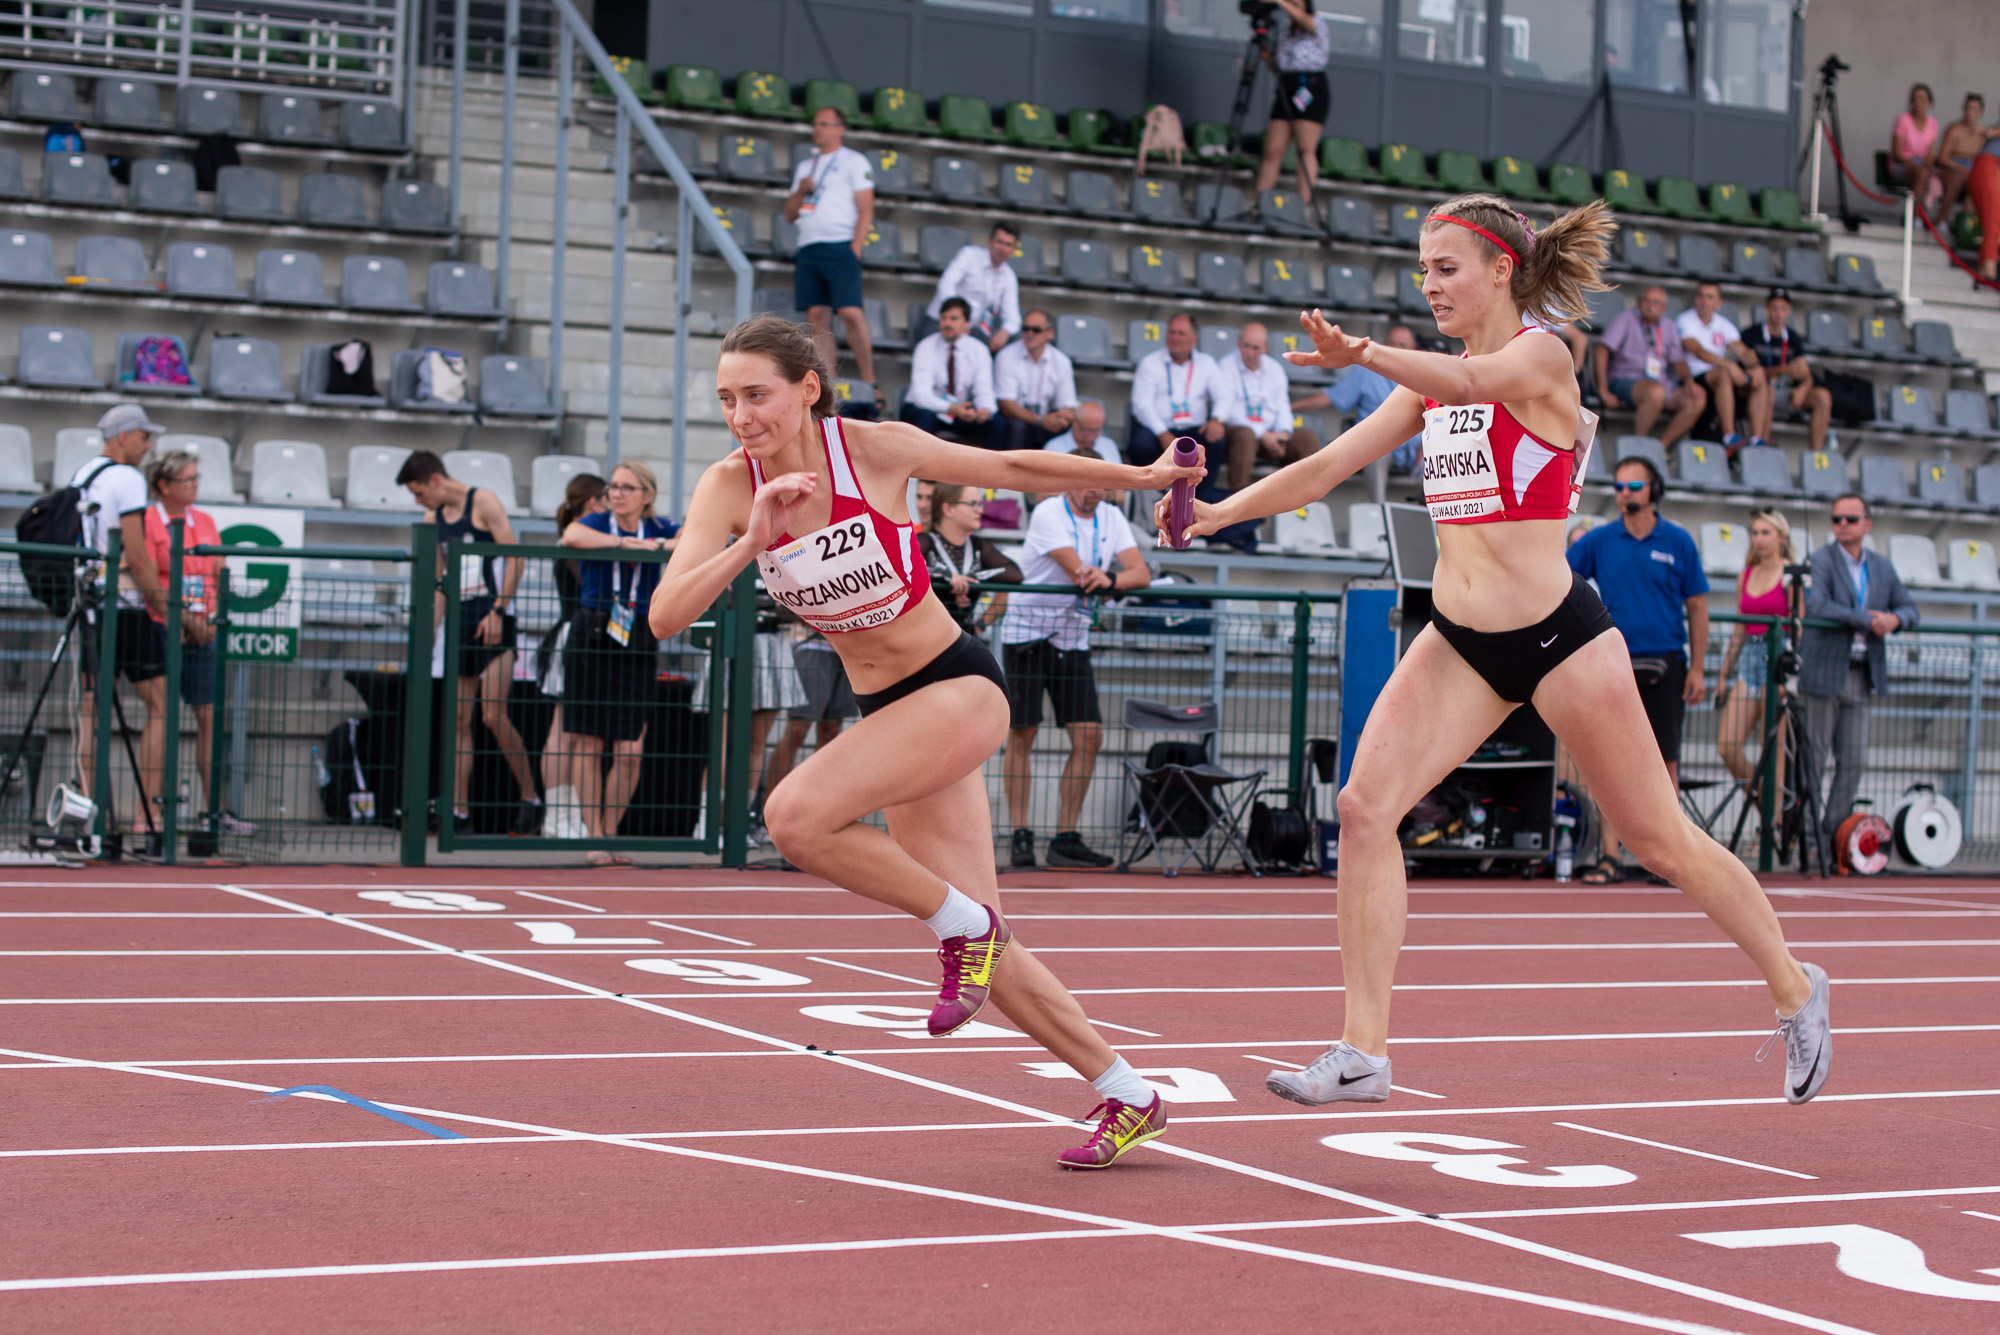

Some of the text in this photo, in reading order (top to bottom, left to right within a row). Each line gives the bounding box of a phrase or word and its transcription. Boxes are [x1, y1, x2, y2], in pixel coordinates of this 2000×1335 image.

[1449, 409, 1486, 435] 225
[1423, 450, 1491, 481] GAJEWSKA
[1463, 502, 1485, 515] 2021
[815, 522, 867, 562] 229
[773, 561, 893, 607] KOCZANOWA
[865, 599, 889, 611] POLSKI
[866, 608, 896, 625] 2021
[227, 632, 290, 656] KTOR
[358, 890, 506, 911] 8
[515, 921, 664, 945] 7
[624, 958, 812, 986] 6
[1320, 1131, 1638, 1188] 3
